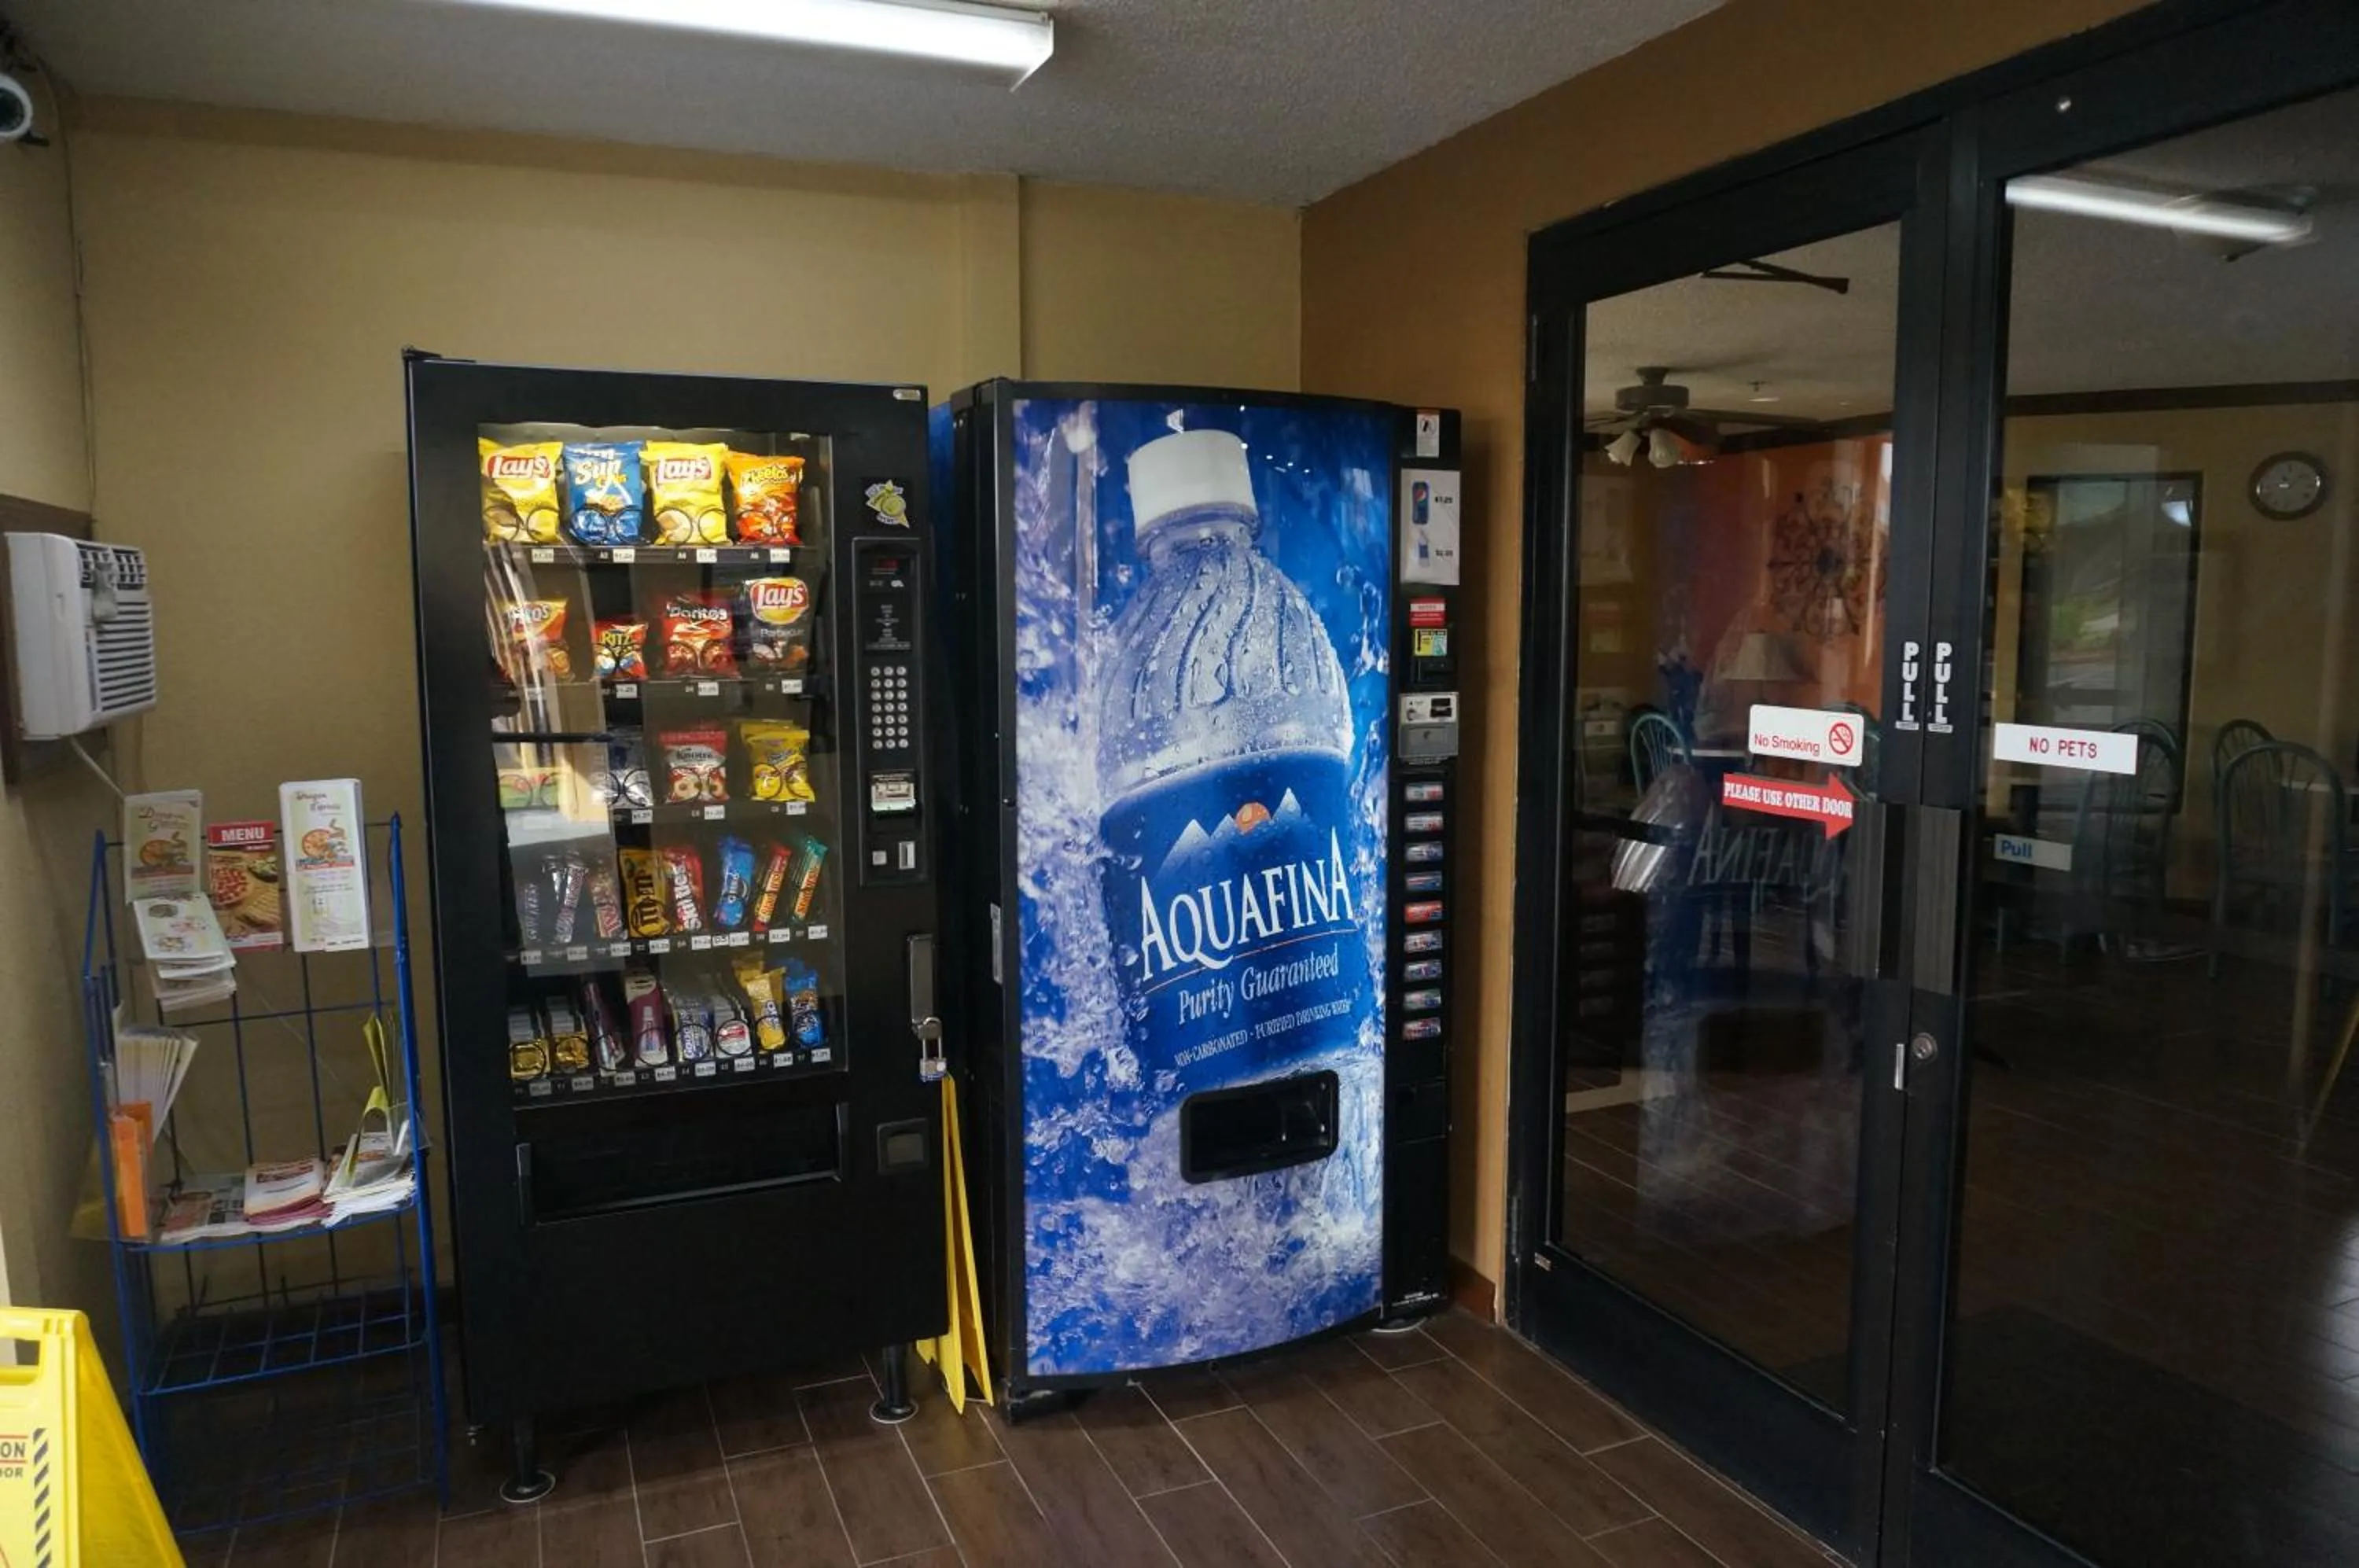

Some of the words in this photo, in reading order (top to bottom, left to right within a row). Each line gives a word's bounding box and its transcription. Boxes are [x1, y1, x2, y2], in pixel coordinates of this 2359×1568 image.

[575, 459, 622, 485] Sun
[1902, 641, 1919, 721] PULL
[1934, 642, 1952, 723] PULL
[1754, 733, 1769, 747] No
[1772, 735, 1820, 756] Smoking
[2029, 737, 2050, 753] NO
[2058, 739, 2097, 759] PETS
[1724, 781, 1761, 803] PLEASE
[1762, 789, 1783, 806] USE
[1785, 792, 1820, 812] OTHER
[1822, 797, 1853, 819] DOOR
[221, 826, 265, 842] MENU
[2000, 839, 2032, 859] Pull
[1141, 825, 1354, 981] AQUAFINA
[1178, 978, 1235, 1026] Purity
[1241, 943, 1339, 1002] Guaranteed
